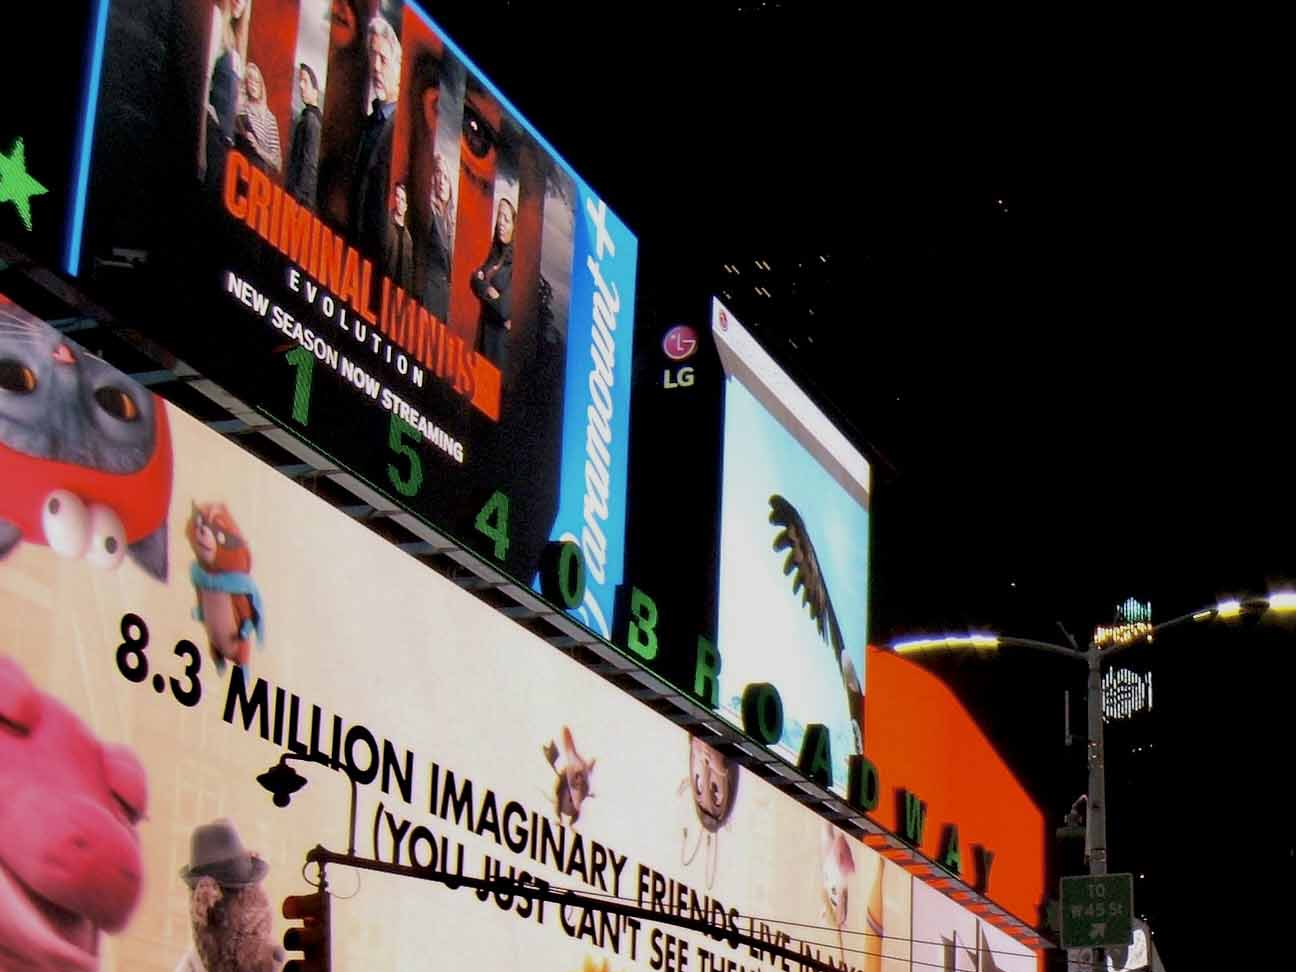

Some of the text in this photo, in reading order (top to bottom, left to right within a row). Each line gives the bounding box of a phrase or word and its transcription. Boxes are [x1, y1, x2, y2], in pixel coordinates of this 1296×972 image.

[222, 150, 377, 326] CRIMINAL
[226, 270, 465, 465] NEW SEASON NOW STREAMING
[288, 268, 424, 388] EVOLUTION
[663, 366, 695, 389] LG
[115, 612, 201, 707] 8.3
[222, 664, 414, 804] MILLION
[428, 762, 628, 900] IMAGINARY
[636, 862, 740, 949] FRIENDS
[372, 803, 465, 890] (YOU
[475, 855, 550, 926] JUST
[557, 898, 642, 964] CAN'T
[1087, 883, 1106, 897] TO
